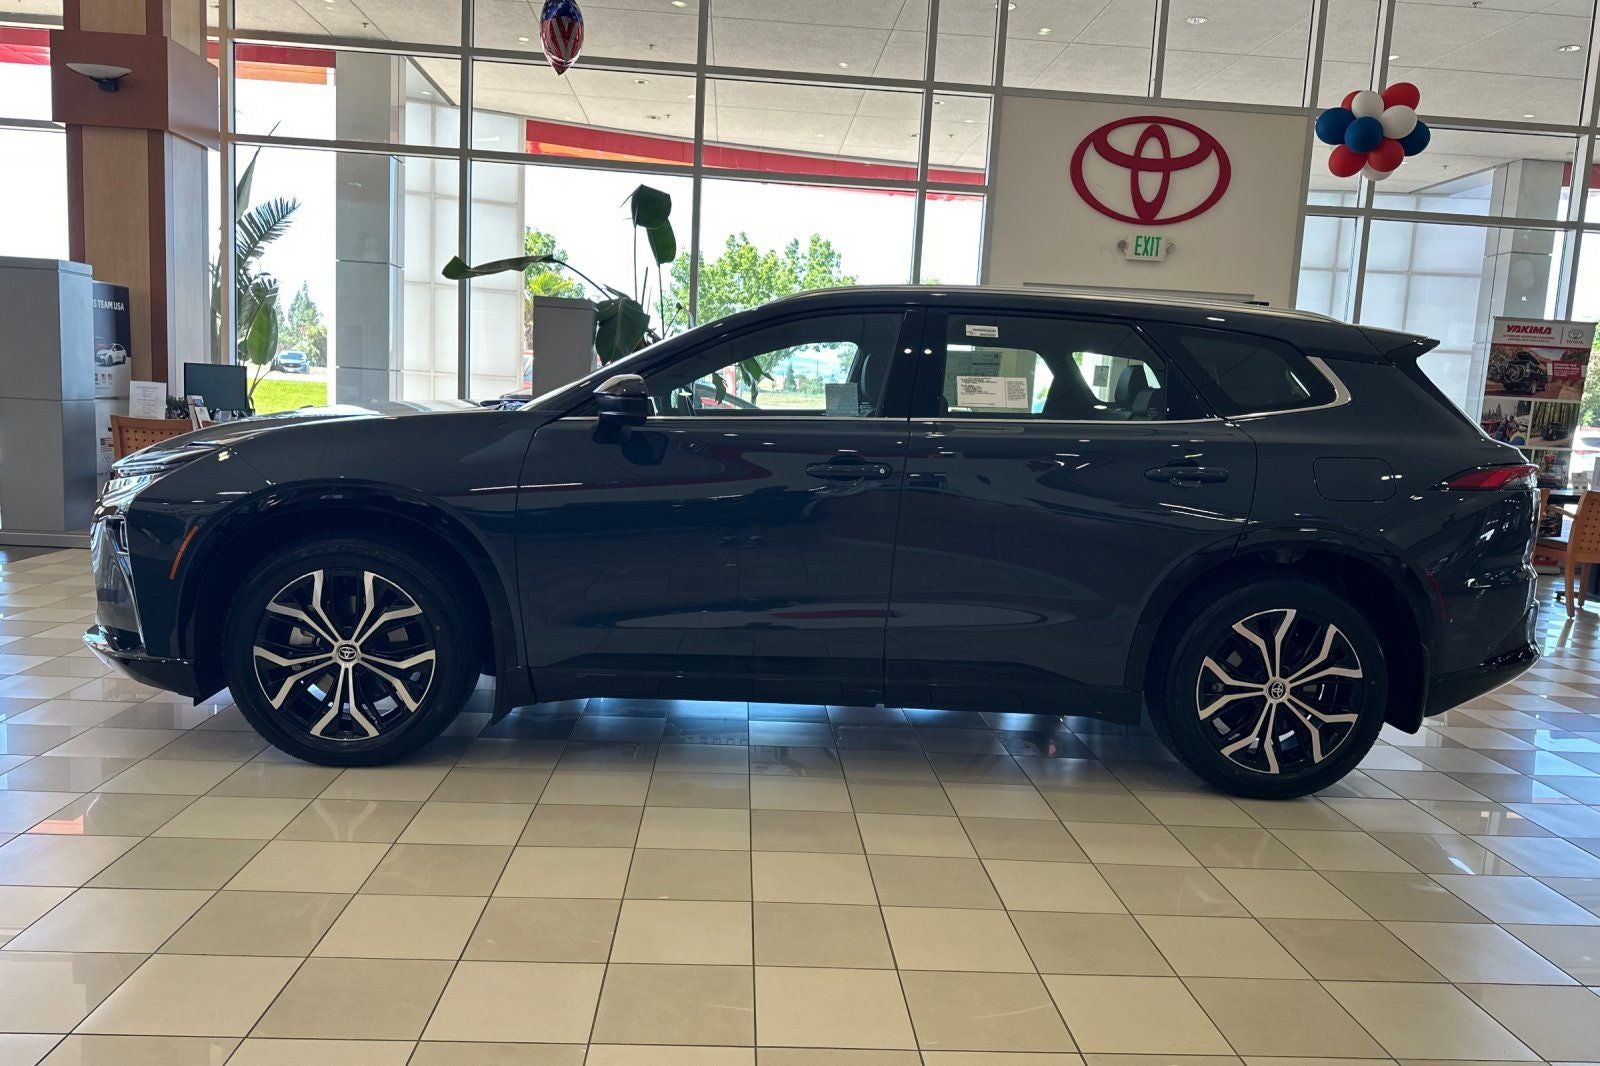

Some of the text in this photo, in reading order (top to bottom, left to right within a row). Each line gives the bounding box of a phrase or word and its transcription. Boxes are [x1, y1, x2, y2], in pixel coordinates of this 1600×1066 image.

[1134, 235, 1162, 257] EXIT
[97, 299, 113, 310] TEAM
[113, 301, 125, 311] USA
[1506, 324, 1552, 335] YAKIMA
